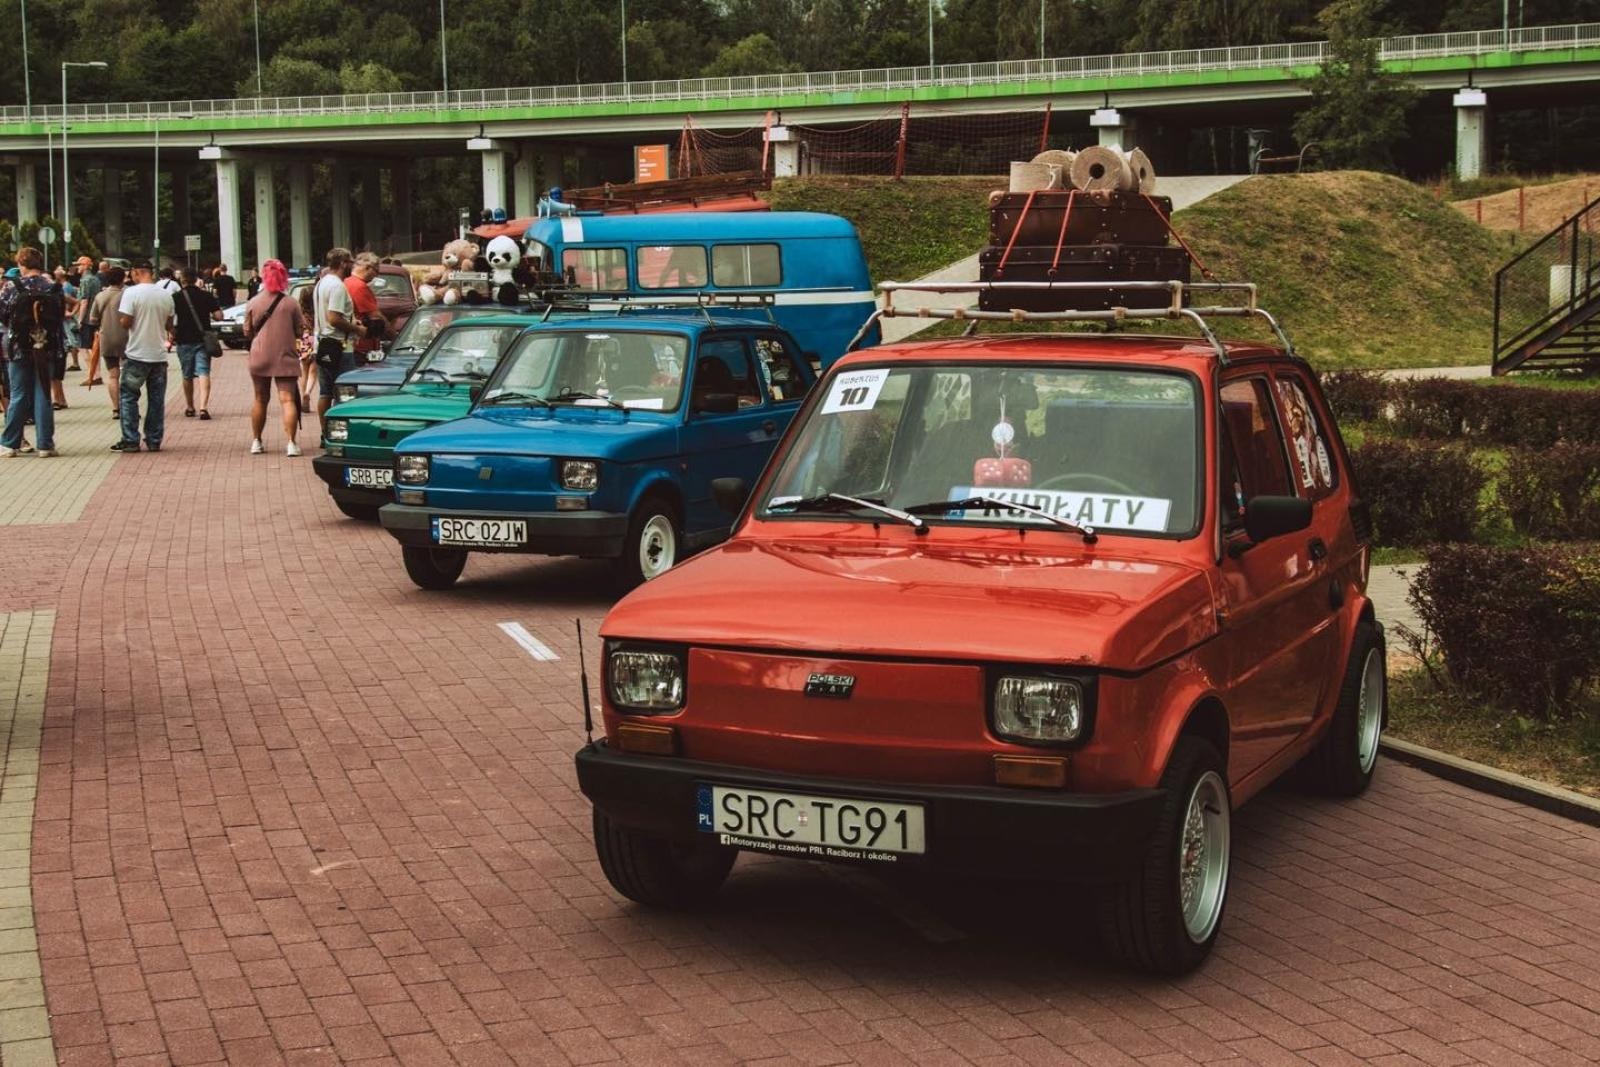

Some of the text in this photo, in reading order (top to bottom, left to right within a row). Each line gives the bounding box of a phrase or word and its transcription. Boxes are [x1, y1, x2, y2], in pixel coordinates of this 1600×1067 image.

[840, 387, 869, 406] 10
[351, 469, 390, 484] SRB EC
[441, 520, 523, 541] SRC 02JW
[809, 674, 852, 684] POLSKI
[699, 814, 712, 825] PL
[722, 793, 907, 849] SRC TG91
[731, 837, 776, 850] Motoryzacja
[868, 853, 898, 861] okolice
